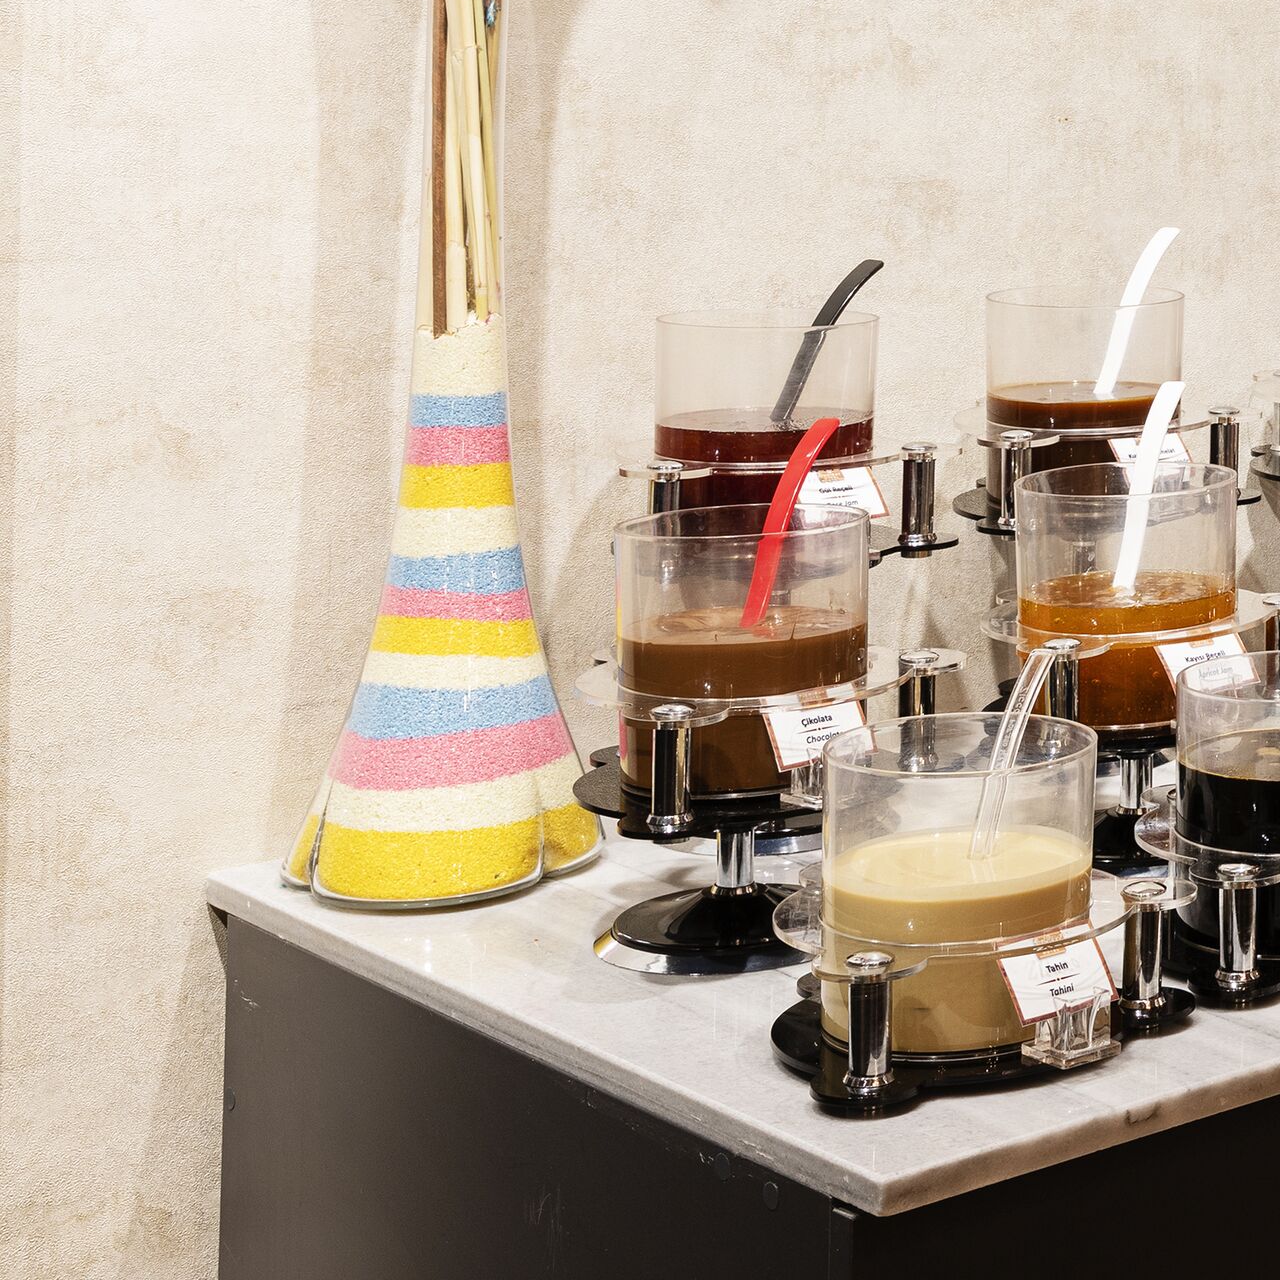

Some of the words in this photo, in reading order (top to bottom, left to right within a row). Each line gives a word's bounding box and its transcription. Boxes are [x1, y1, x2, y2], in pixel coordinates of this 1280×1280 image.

[801, 714, 833, 728] Çikolata
[1045, 961, 1069, 974] Tahin
[1050, 982, 1075, 997] Tahini
